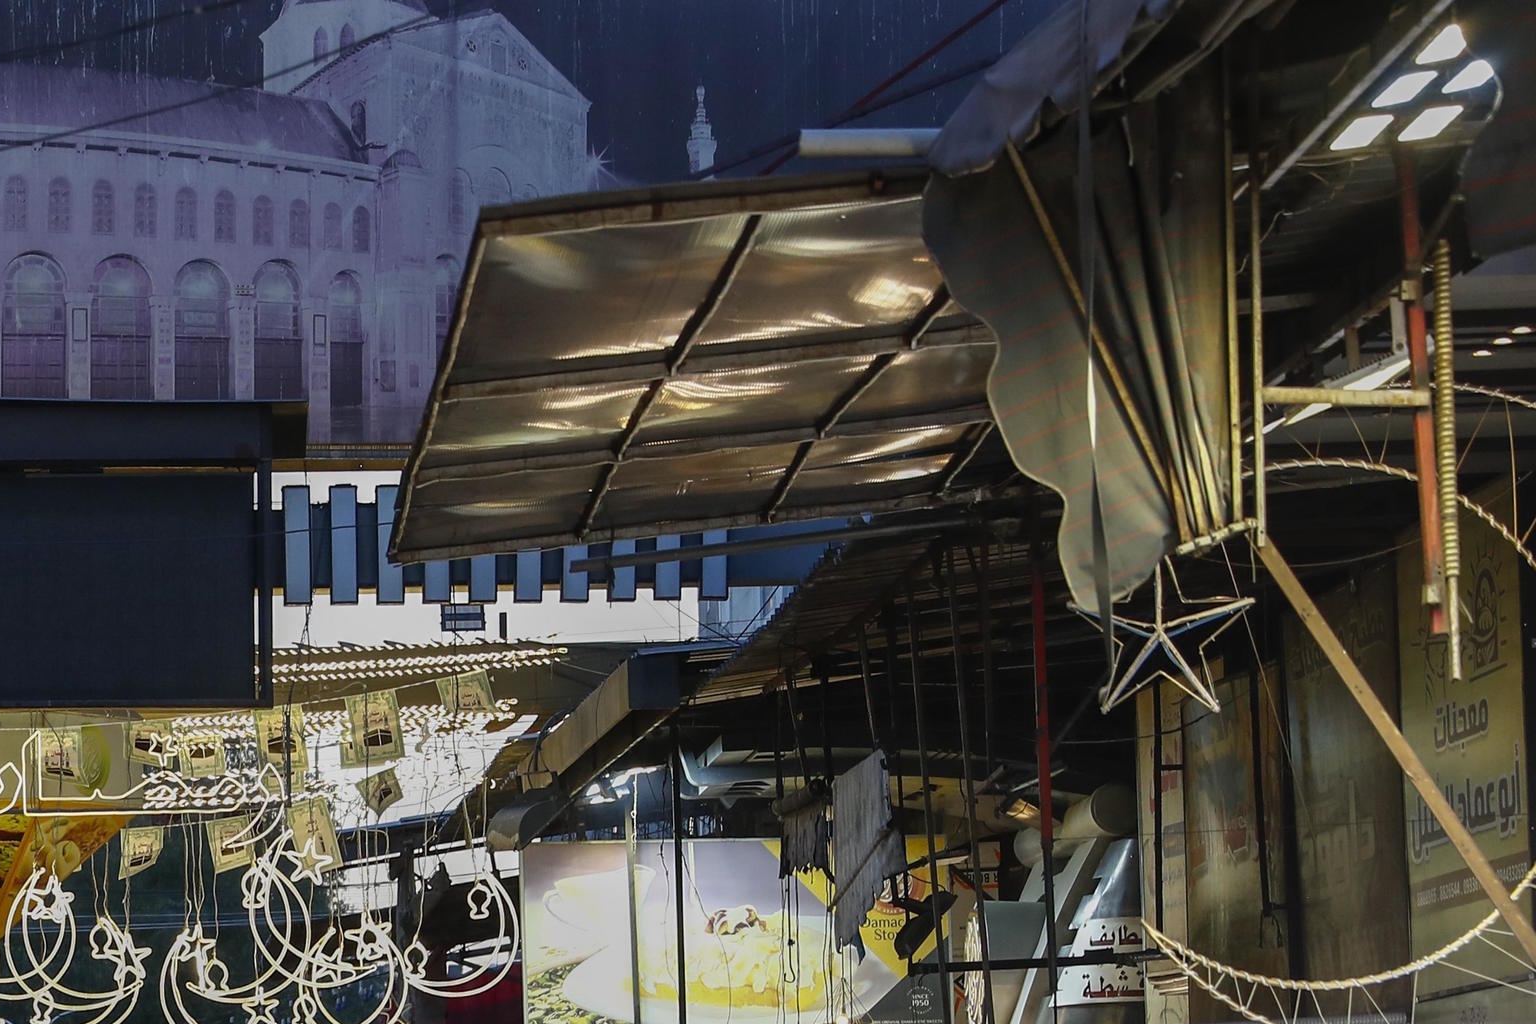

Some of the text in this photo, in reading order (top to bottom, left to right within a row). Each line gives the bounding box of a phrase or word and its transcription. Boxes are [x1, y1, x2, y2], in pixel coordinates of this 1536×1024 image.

[1433, 697, 1489, 754] معجنات
[1457, 776, 1497, 834] عماد
[1498, 742, 1522, 839] أبو
